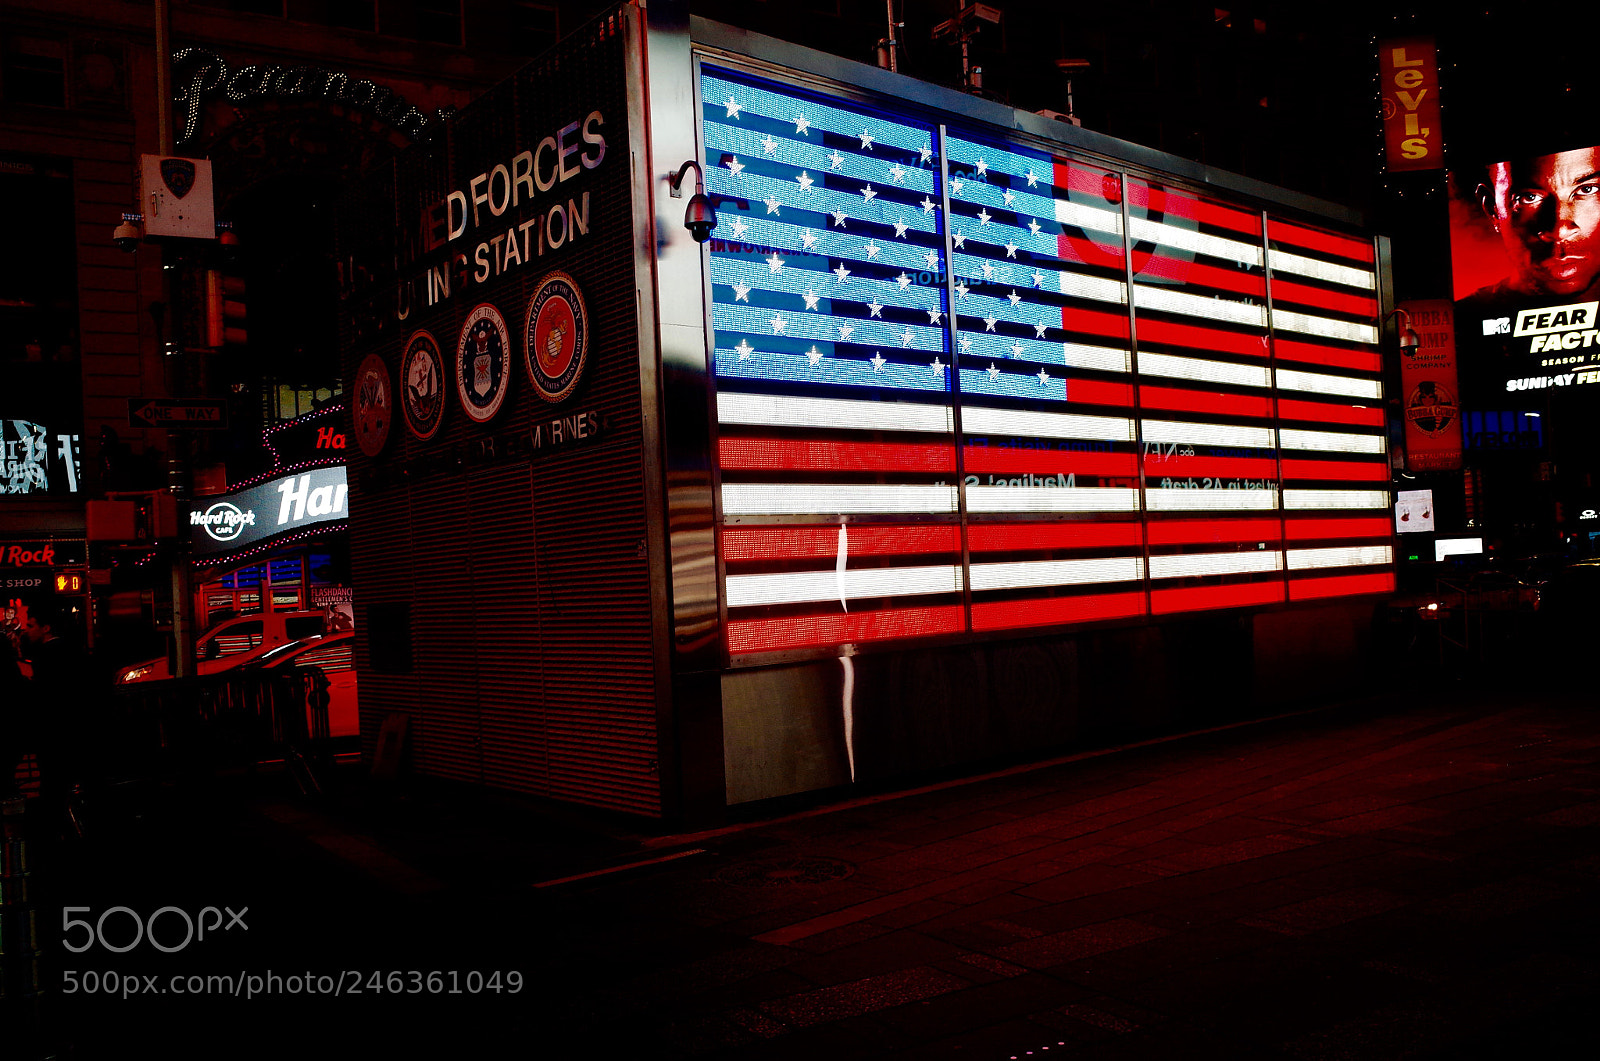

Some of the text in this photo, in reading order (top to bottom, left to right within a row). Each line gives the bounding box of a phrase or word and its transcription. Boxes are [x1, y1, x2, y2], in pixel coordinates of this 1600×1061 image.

[172, 47, 458, 145] Paramoun
[469, 110, 606, 228] FORCES
[474, 191, 590, 284] STATION
[484, 308, 495, 319] THE
[1522, 308, 1588, 331] FEAR
[1416, 332, 1449, 348] UMP
[1530, 329, 1600, 354] FACT
[1406, 362, 1452, 370] COMPANY
[1411, 354, 1448, 362] SHRIMP
[1541, 355, 1585, 367] SEASON
[1576, 371, 1600, 385] FE
[144, 407, 214, 419] ONE WAY
[190, 510, 256, 527] Hard Rock
[8, 544, 55, 567] Rock
[6, 578, 42, 588] SHOP
